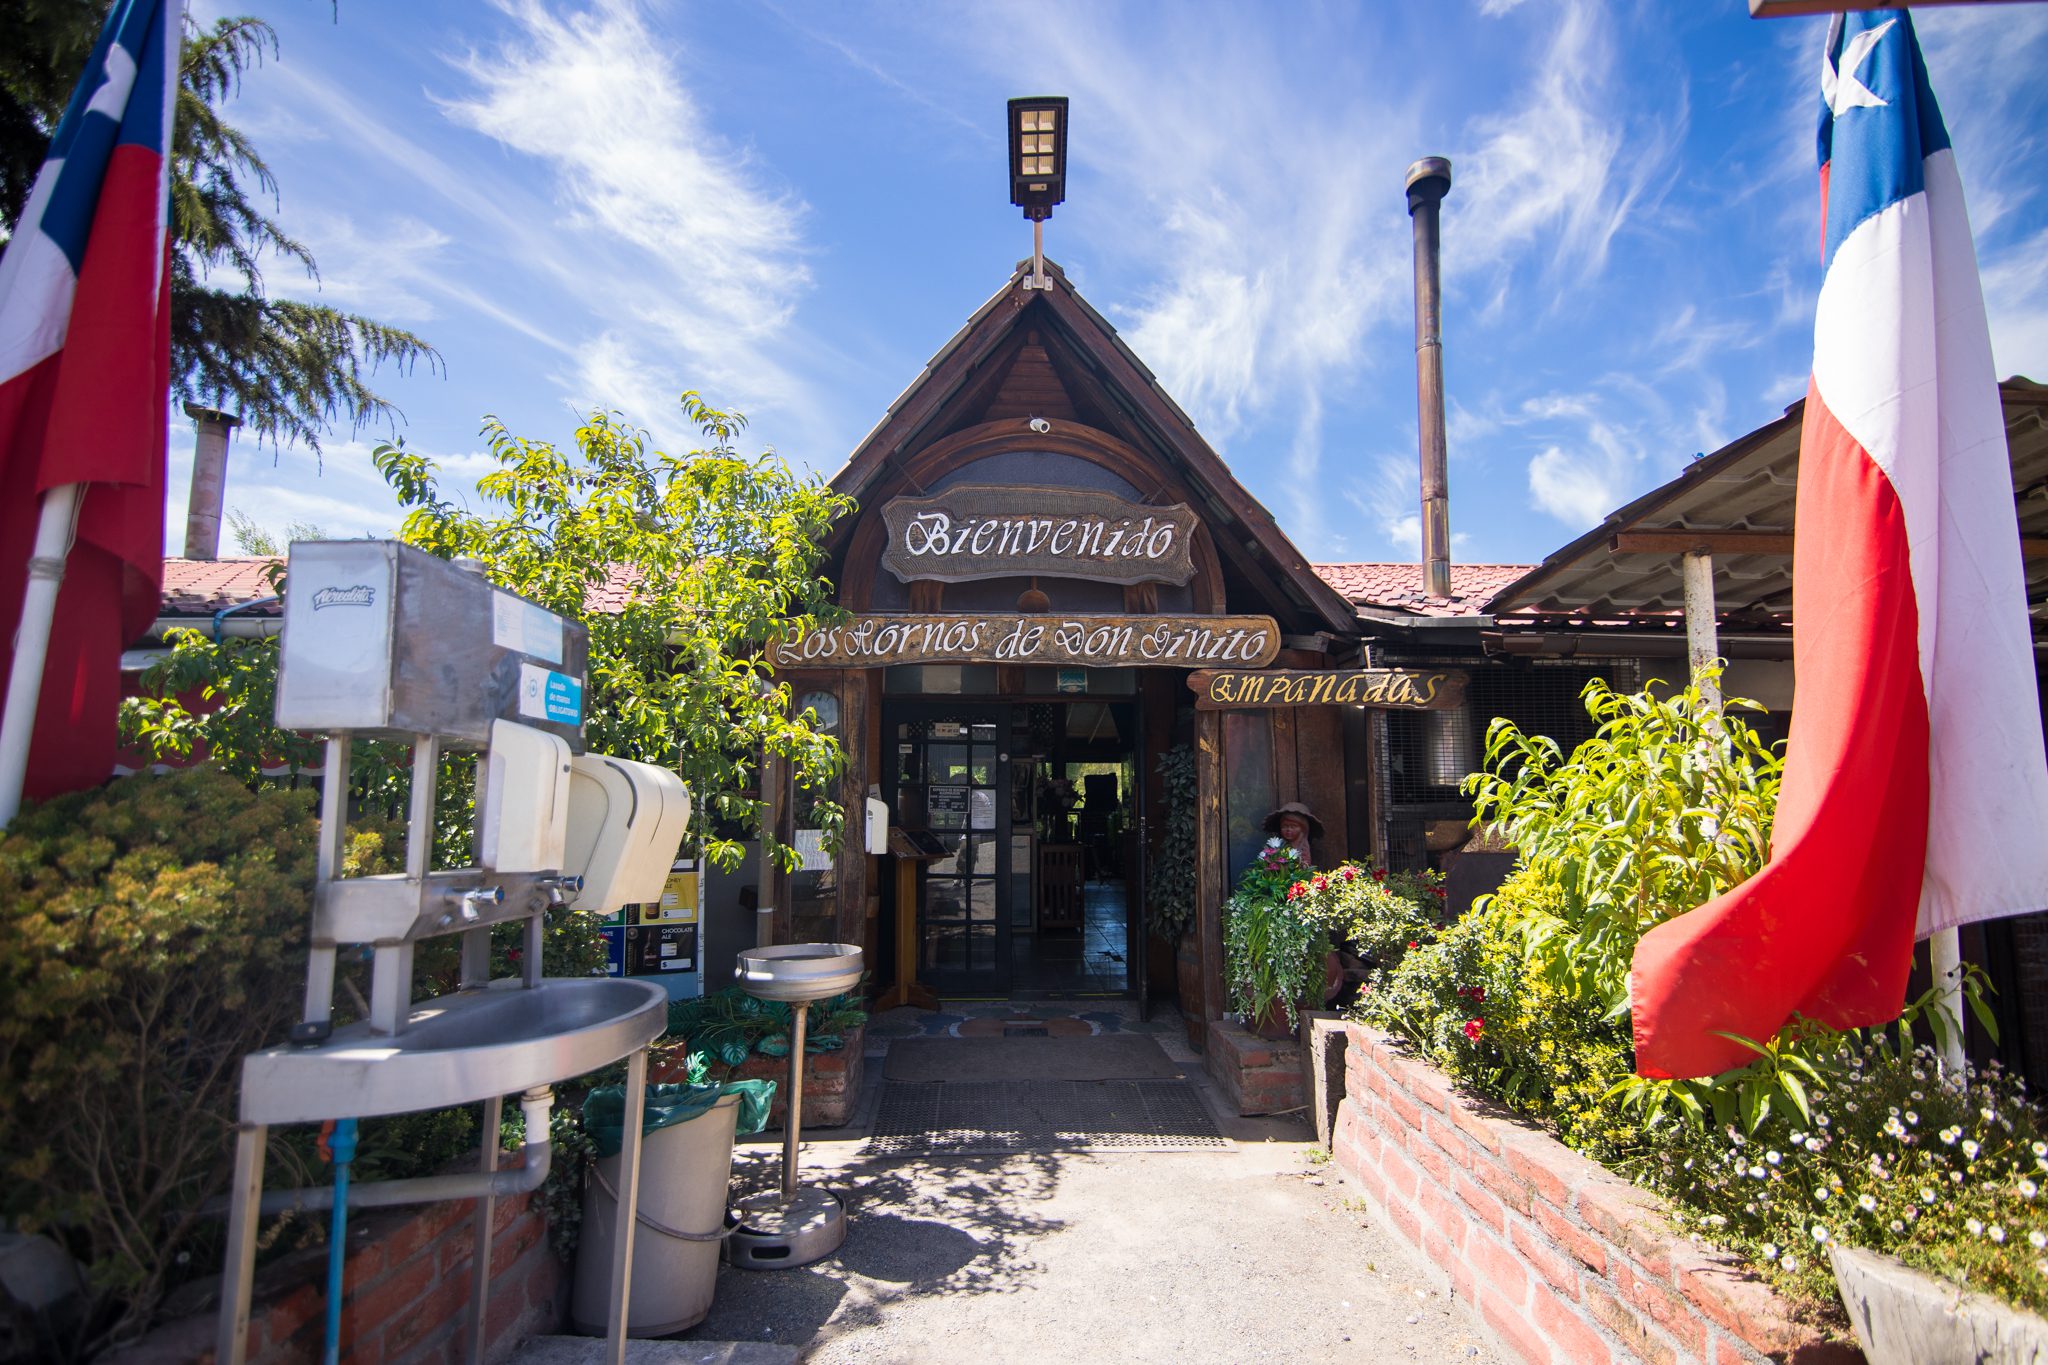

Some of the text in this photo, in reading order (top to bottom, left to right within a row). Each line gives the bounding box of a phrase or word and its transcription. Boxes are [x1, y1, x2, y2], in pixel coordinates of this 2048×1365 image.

[904, 511, 1175, 559] Bienvenido
[776, 624, 842, 664] Los
[844, 619, 987, 656] Hornos
[994, 619, 1045, 659] de
[1054, 621, 1133, 656] Don
